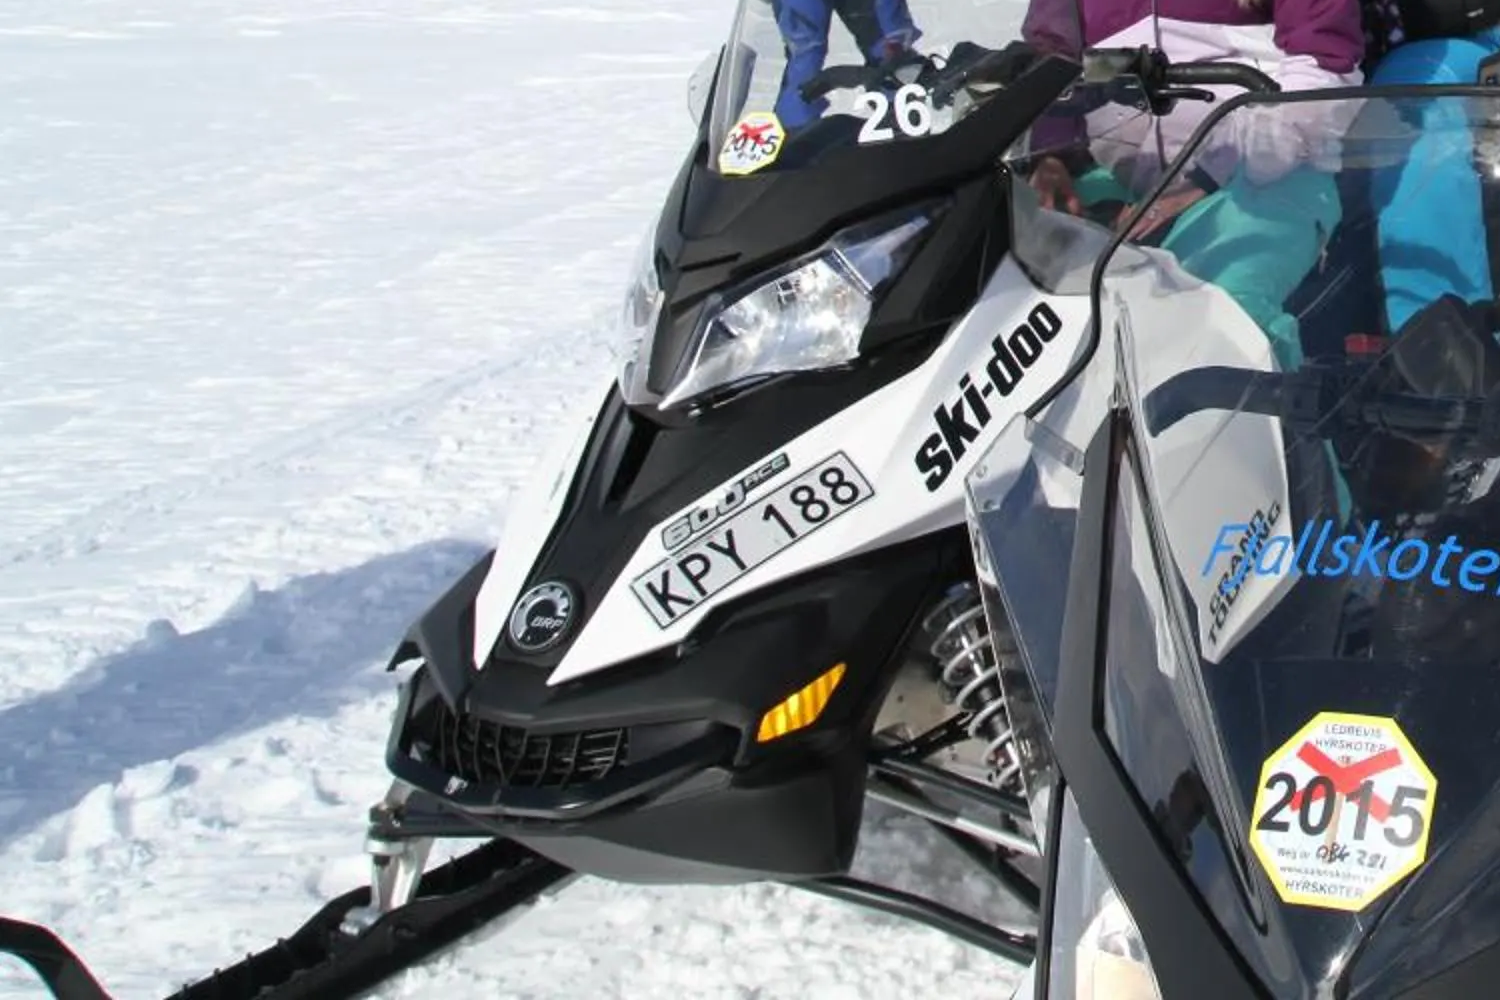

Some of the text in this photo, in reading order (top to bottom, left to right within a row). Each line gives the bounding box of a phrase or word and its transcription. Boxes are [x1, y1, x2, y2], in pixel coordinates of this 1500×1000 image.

[724, 132, 780, 156] 2015
[857, 83, 932, 144] 26
[914, 301, 1063, 493] ski-doo
[645, 466, 860, 619] KPY 188
[661, 480, 747, 551] 600
[1255, 771, 1429, 848] 2015
[1285, 879, 1364, 898] HYRSKOTER
